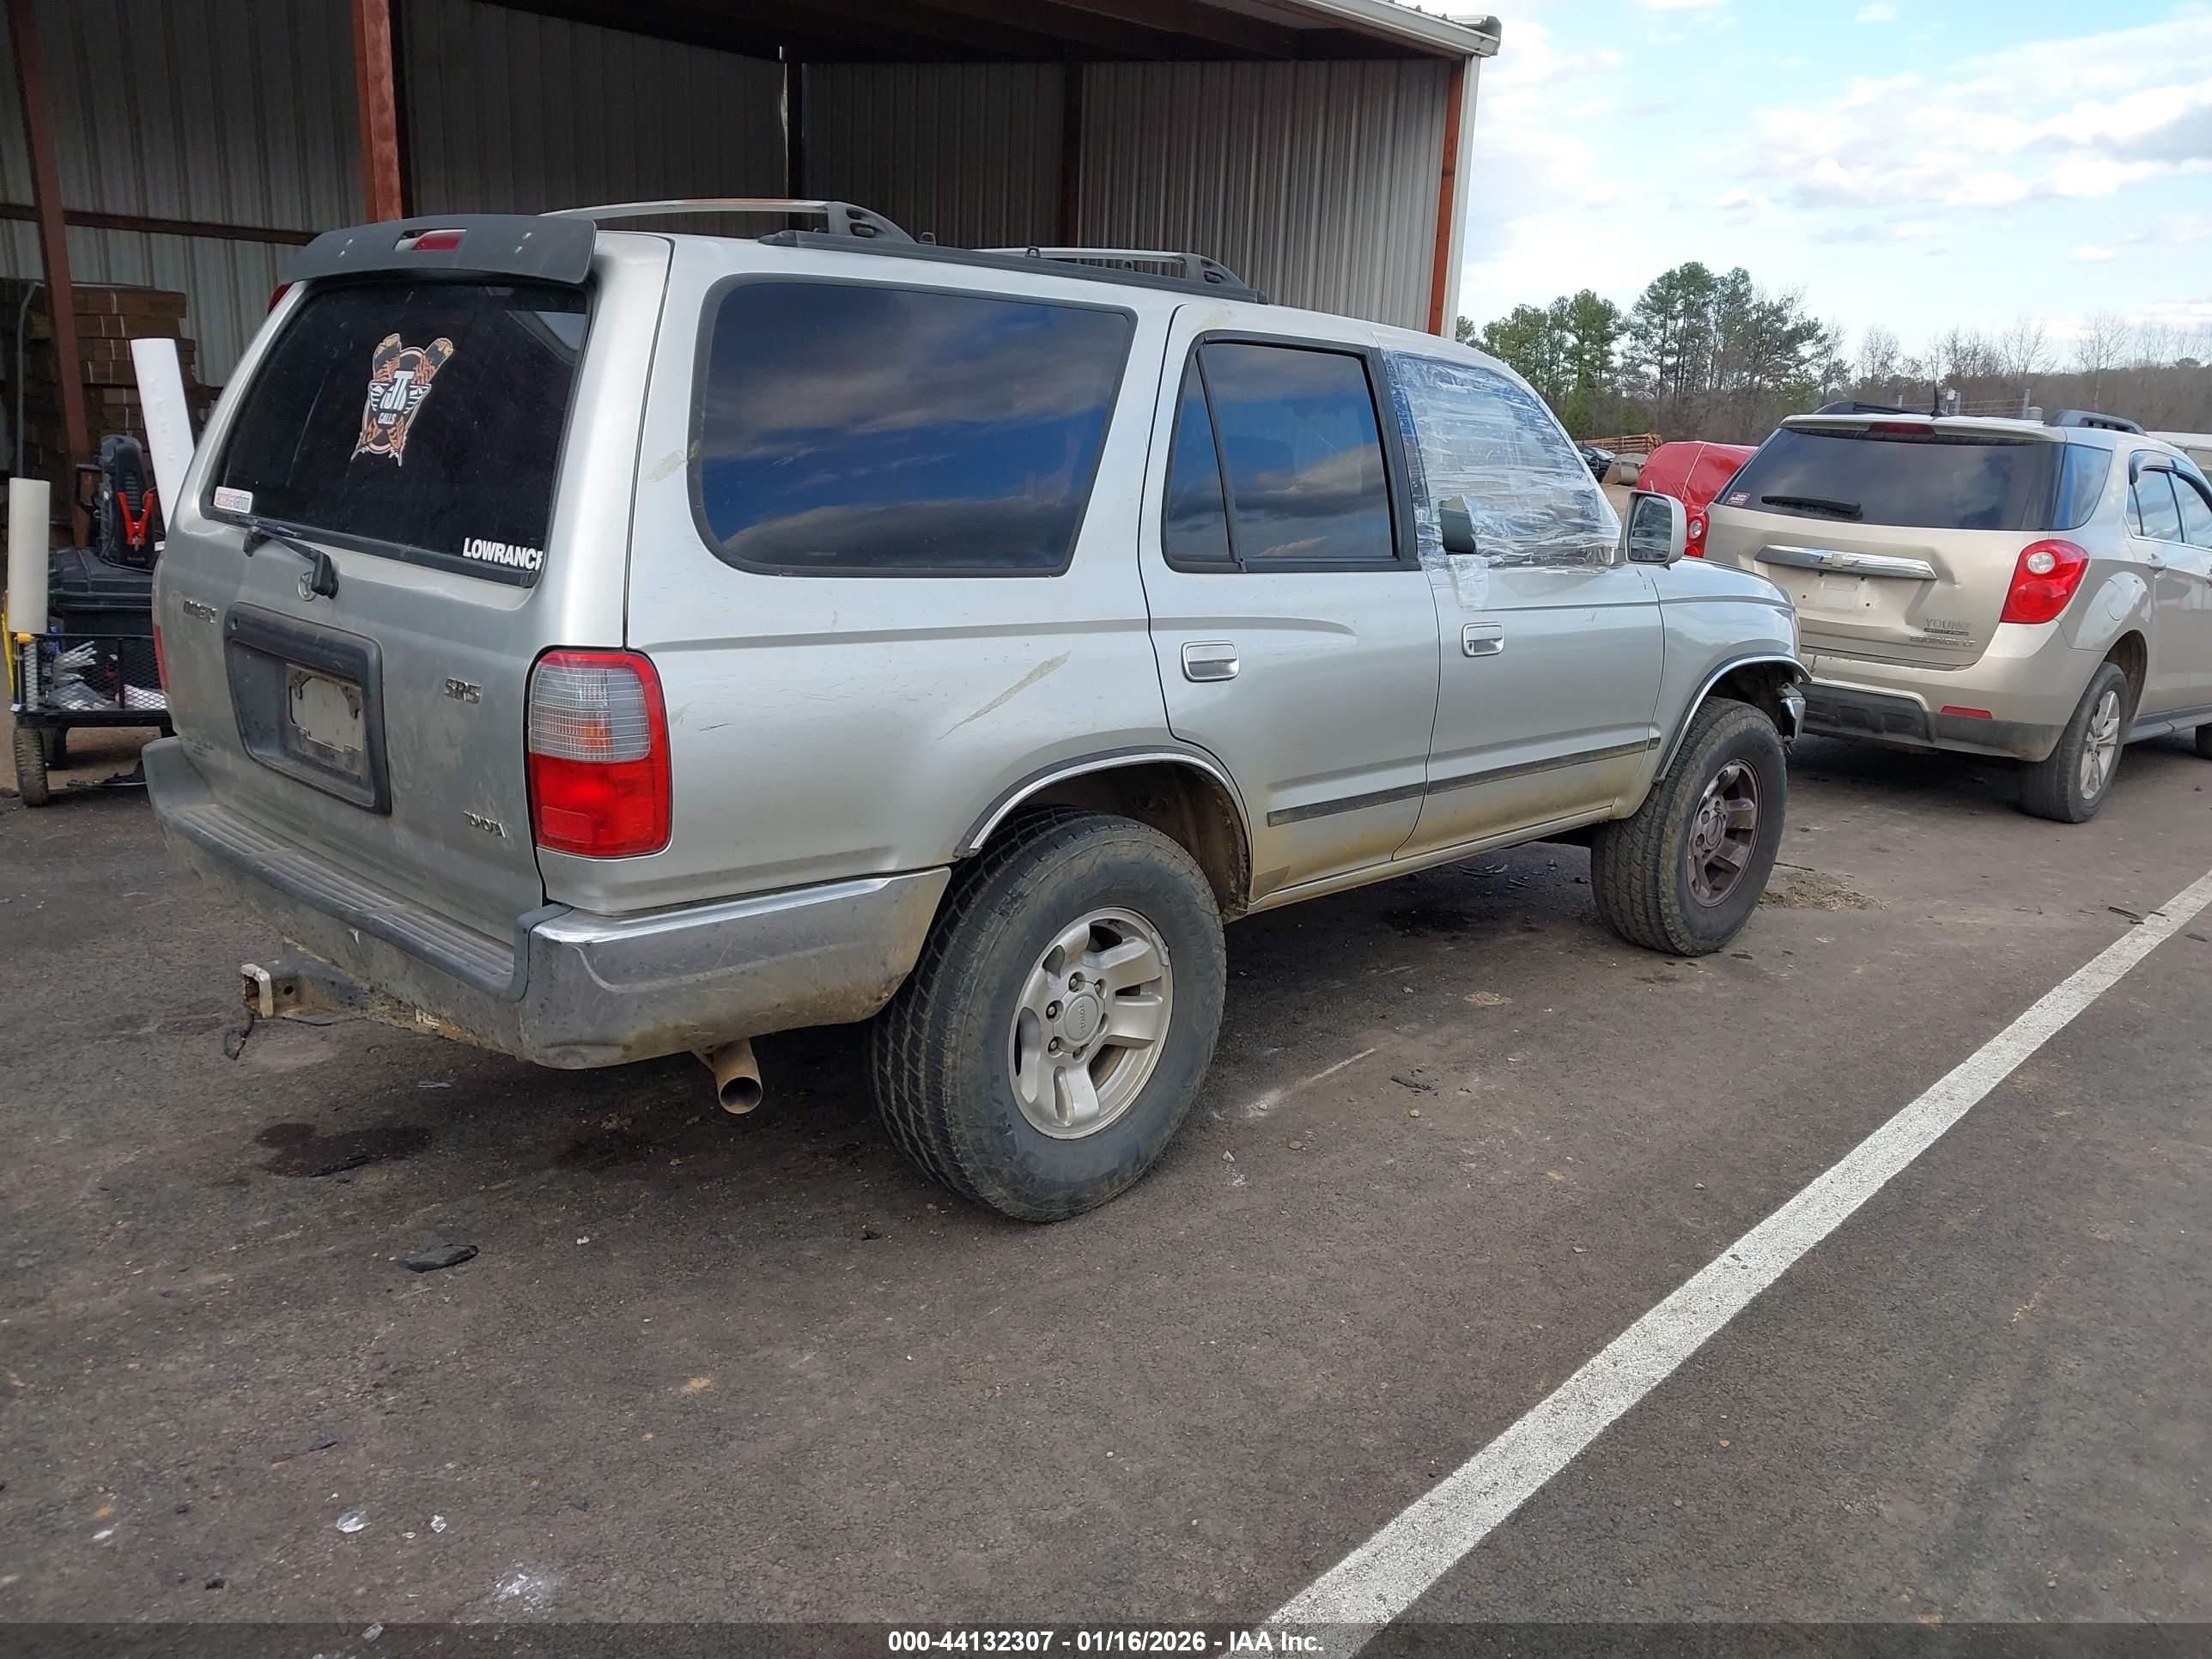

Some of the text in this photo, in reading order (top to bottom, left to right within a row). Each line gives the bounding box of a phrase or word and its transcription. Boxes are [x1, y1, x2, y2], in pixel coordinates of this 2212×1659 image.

[378, 411, 398, 425] CALLS
[1909, 635, 1962, 647] EQUINOX
[445, 676, 482, 705] SR5
[463, 810, 507, 839] TOYOTA
[1078, 1002, 1086, 1036] TOYOTA
